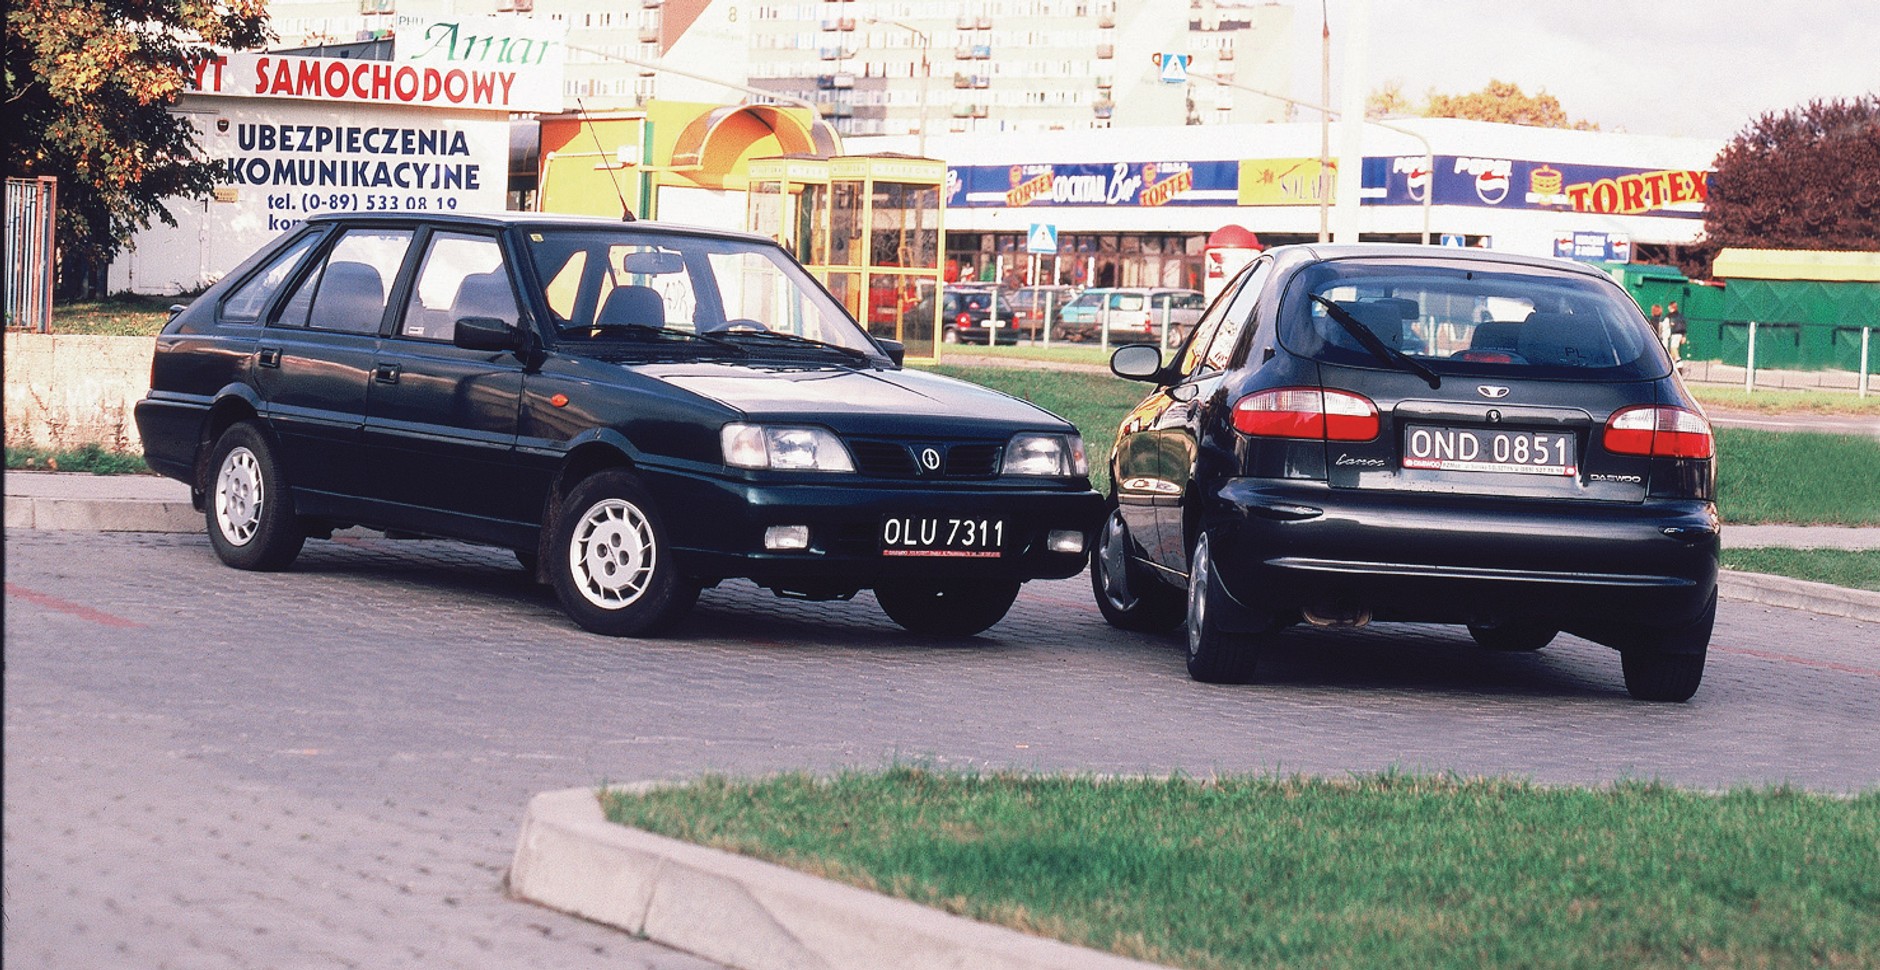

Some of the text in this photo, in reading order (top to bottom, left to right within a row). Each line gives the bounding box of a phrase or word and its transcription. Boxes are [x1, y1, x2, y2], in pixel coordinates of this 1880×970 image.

[410, 22, 559, 65] Amar
[255, 57, 516, 105] SAMOCHODOWY
[238, 123, 470, 156] UBEZPIECZENIA
[227, 157, 480, 190] KOMUNIKACYJNE
[267, 193, 296, 210] tel.
[301, 193, 358, 213] (0-89)
[366, 194, 399, 211] 533
[406, 196, 428, 210] 08
[1567, 171, 1708, 214] TORTEX
[1335, 453, 1385, 467] Lanos
[1411, 430, 1566, 466] OND 0851
[1590, 473, 1642, 483] DAEWOO
[884, 518, 1003, 547] OLU 7311
